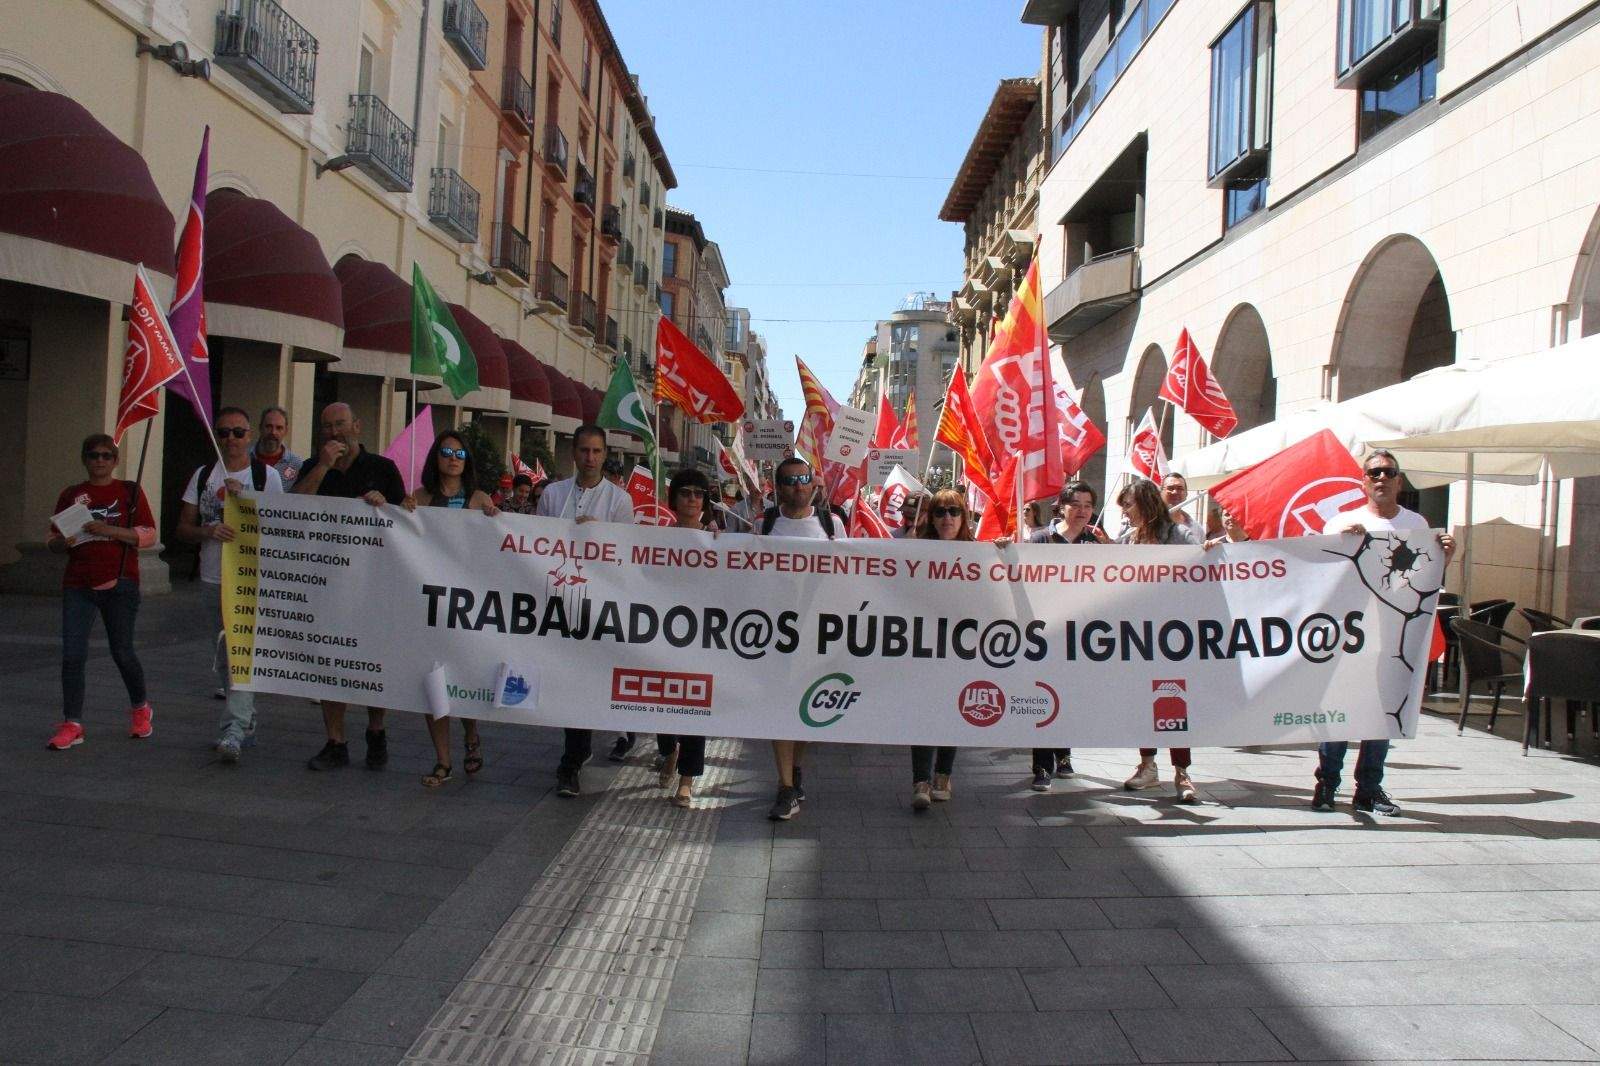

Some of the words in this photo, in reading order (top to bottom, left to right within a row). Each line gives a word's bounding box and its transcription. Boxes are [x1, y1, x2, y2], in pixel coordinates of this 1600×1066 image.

[239, 505, 257, 516] SIN
[258, 508, 338, 523] CONCILIACIÓN
[340, 514, 394, 529] FAMILIAR
[240, 523, 258, 534] SIN
[260, 526, 305, 540] CARRERA
[309, 531, 385, 547] PROFESIONAL
[239, 544, 258, 557] SIN
[260, 548, 350, 567] RECLASIFICACIÓN
[500, 533, 623, 566] ALCALDE,
[631, 546, 719, 569] MENOS
[726, 551, 897, 577] EXPEDIENTES
[905, 559, 921, 577] Y
[928, 557, 981, 581] MÁS
[989, 564, 1096, 583] CUMPLIR
[1103, 559, 1287, 584] COMPROMISOS
[238, 566, 257, 578] SIN
[260, 569, 327, 586] VALORACIÓN
[236, 585, 256, 597] SIN
[259, 588, 309, 603] MATERIAL
[234, 604, 254, 616] SIN
[258, 608, 315, 624] VESTUARIO
[233, 623, 253, 635] SIN
[256, 626, 304, 642] MEJORAS
[307, 633, 358, 648] SOCIALES
[422, 584, 801, 660] TRABAJADOR@S
[817, 601, 1048, 669] PÚBLIC@S
[1066, 610, 1364, 664] IGNORAD@S
[231, 644, 251, 656] SIN
[255, 648, 315, 665] PROVISIÓN
[317, 656, 331, 667] DE
[334, 658, 382, 673] PUESTOS
[231, 664, 250, 676] SIN
[253, 667, 338, 687] INSTALACIONES
[341, 678, 384, 693] DIGNAS
[619, 675, 707, 700] CCOO
[812, 689, 861, 710] CSIF
[964, 688, 999, 706] UGT
[1010, 695, 1049, 705] Servicios
[610, 703, 647, 712] servicios
[656, 705, 664, 713] la
[1010, 706, 1046, 715] Públicos
[1272, 710, 1346, 726] #BastaYa
[1156, 718, 1186, 730] CGT
